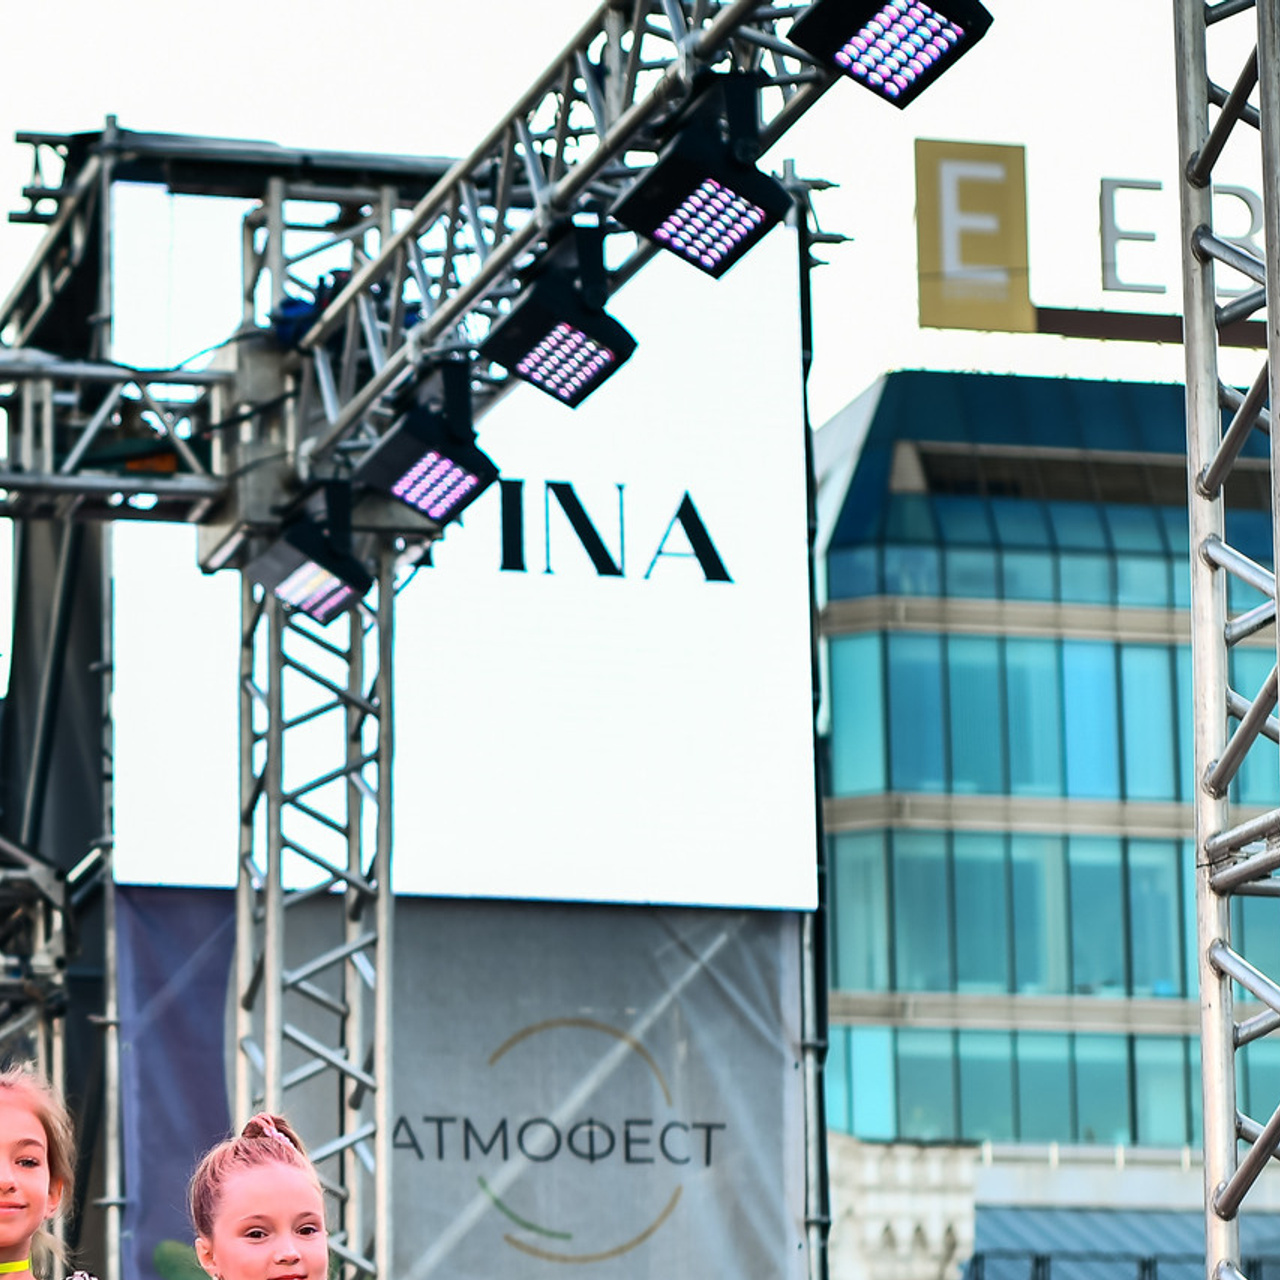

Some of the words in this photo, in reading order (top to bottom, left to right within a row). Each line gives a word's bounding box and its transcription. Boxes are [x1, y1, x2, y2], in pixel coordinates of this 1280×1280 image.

[939, 159, 1011, 284] E
[417, 478, 735, 584] INA
[392, 1115, 727, 1168] АТМОФЕСТ
